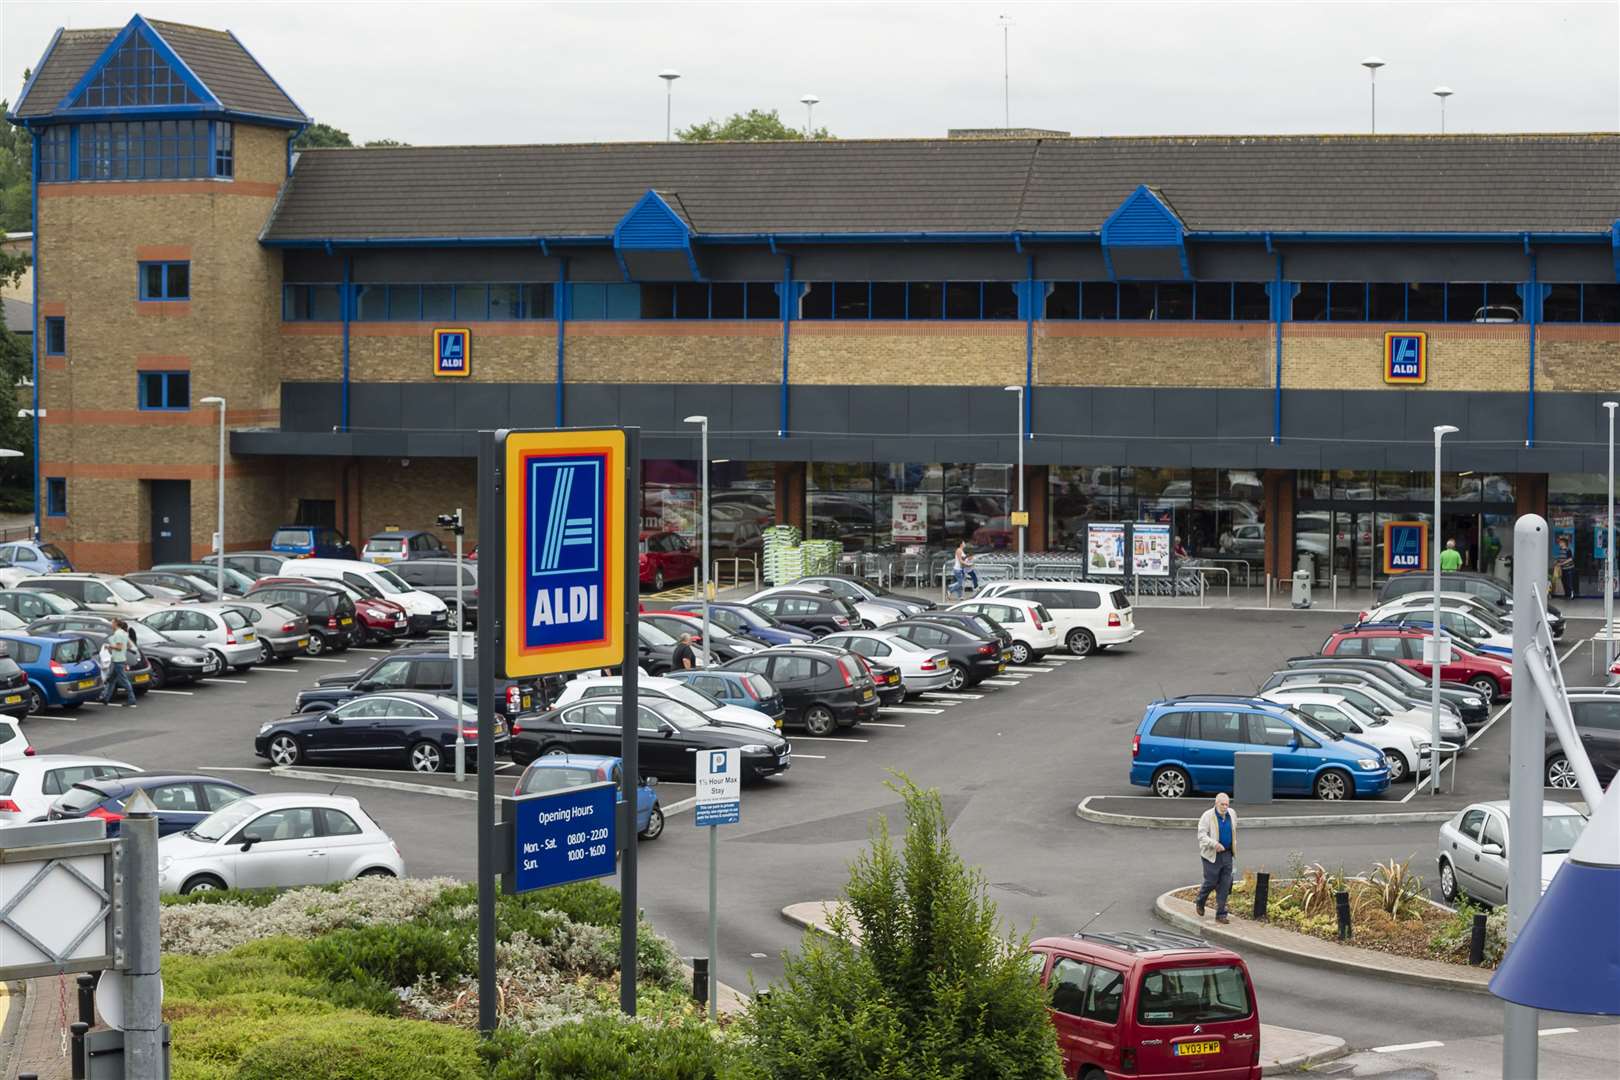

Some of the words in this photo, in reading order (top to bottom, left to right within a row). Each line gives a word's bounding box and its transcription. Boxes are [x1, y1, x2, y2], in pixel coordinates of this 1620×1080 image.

[442, 358, 462, 367] ALDI
[1392, 364, 1417, 374] ALDI
[1393, 555, 1419, 566] ALDI
[532, 584, 598, 627] ALDI
[712, 753, 725, 773] P
[711, 787, 724, 795] Stay
[538, 808, 571, 826] Opening
[571, 805, 594, 818] Hours
[523, 842, 539, 854] Mon.
[545, 838, 557, 850] Sat.
[567, 832, 586, 845] 08.00
[590, 828, 609, 841] 22.00
[523, 859, 539, 871] Sun.
[567, 848, 584, 861] 10.00
[589, 844, 606, 857] 16.00
[1180, 1043, 1202, 1054] LY03
[1204, 1041, 1219, 1052] FWP
